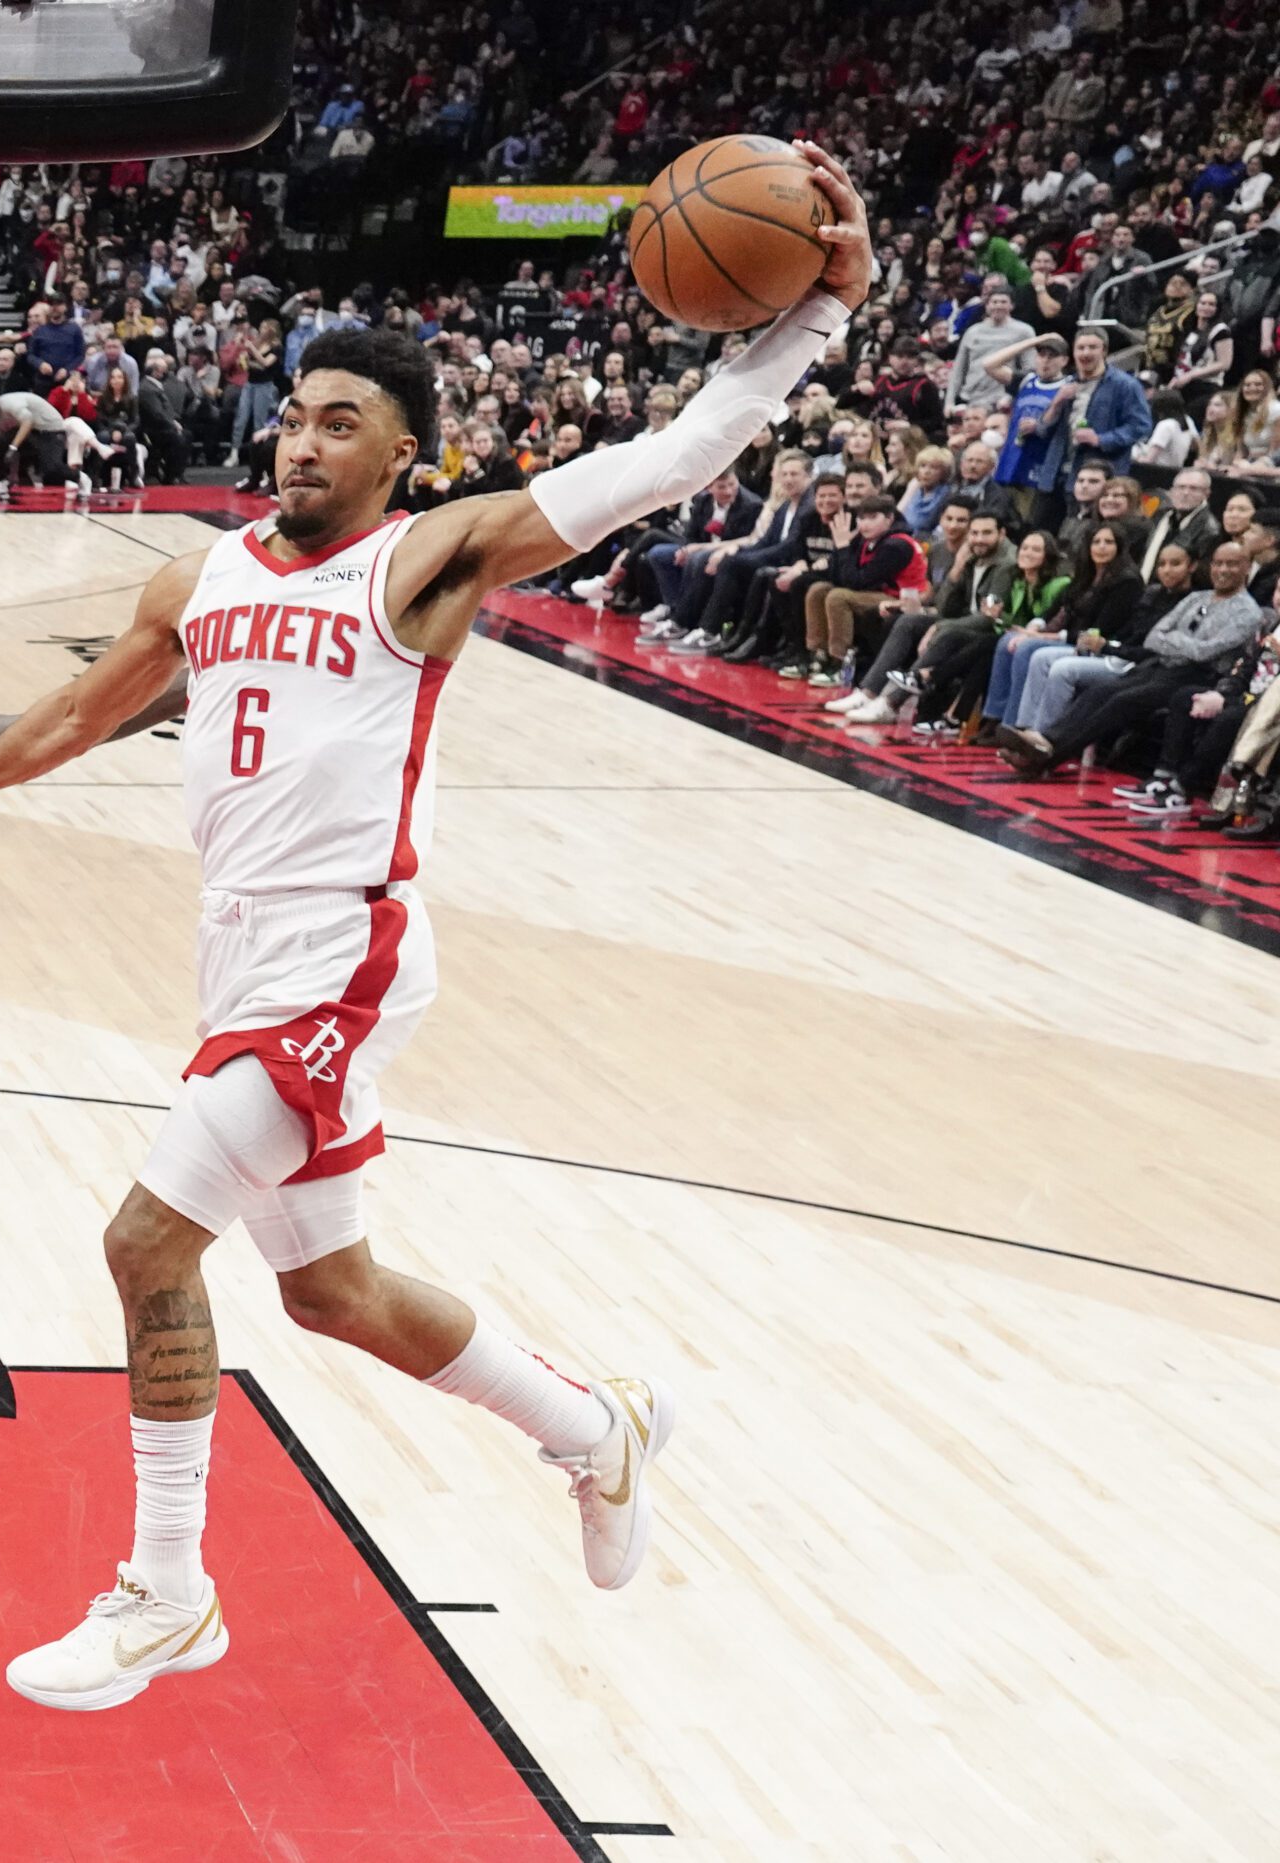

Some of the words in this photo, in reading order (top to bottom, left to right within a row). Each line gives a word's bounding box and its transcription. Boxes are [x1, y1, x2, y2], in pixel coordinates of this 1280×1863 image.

[493, 195, 609, 229] Tangerine
[313, 570, 367, 585] MONEY
[185, 603, 362, 681] ROCKETS
[230, 687, 271, 778] 6
